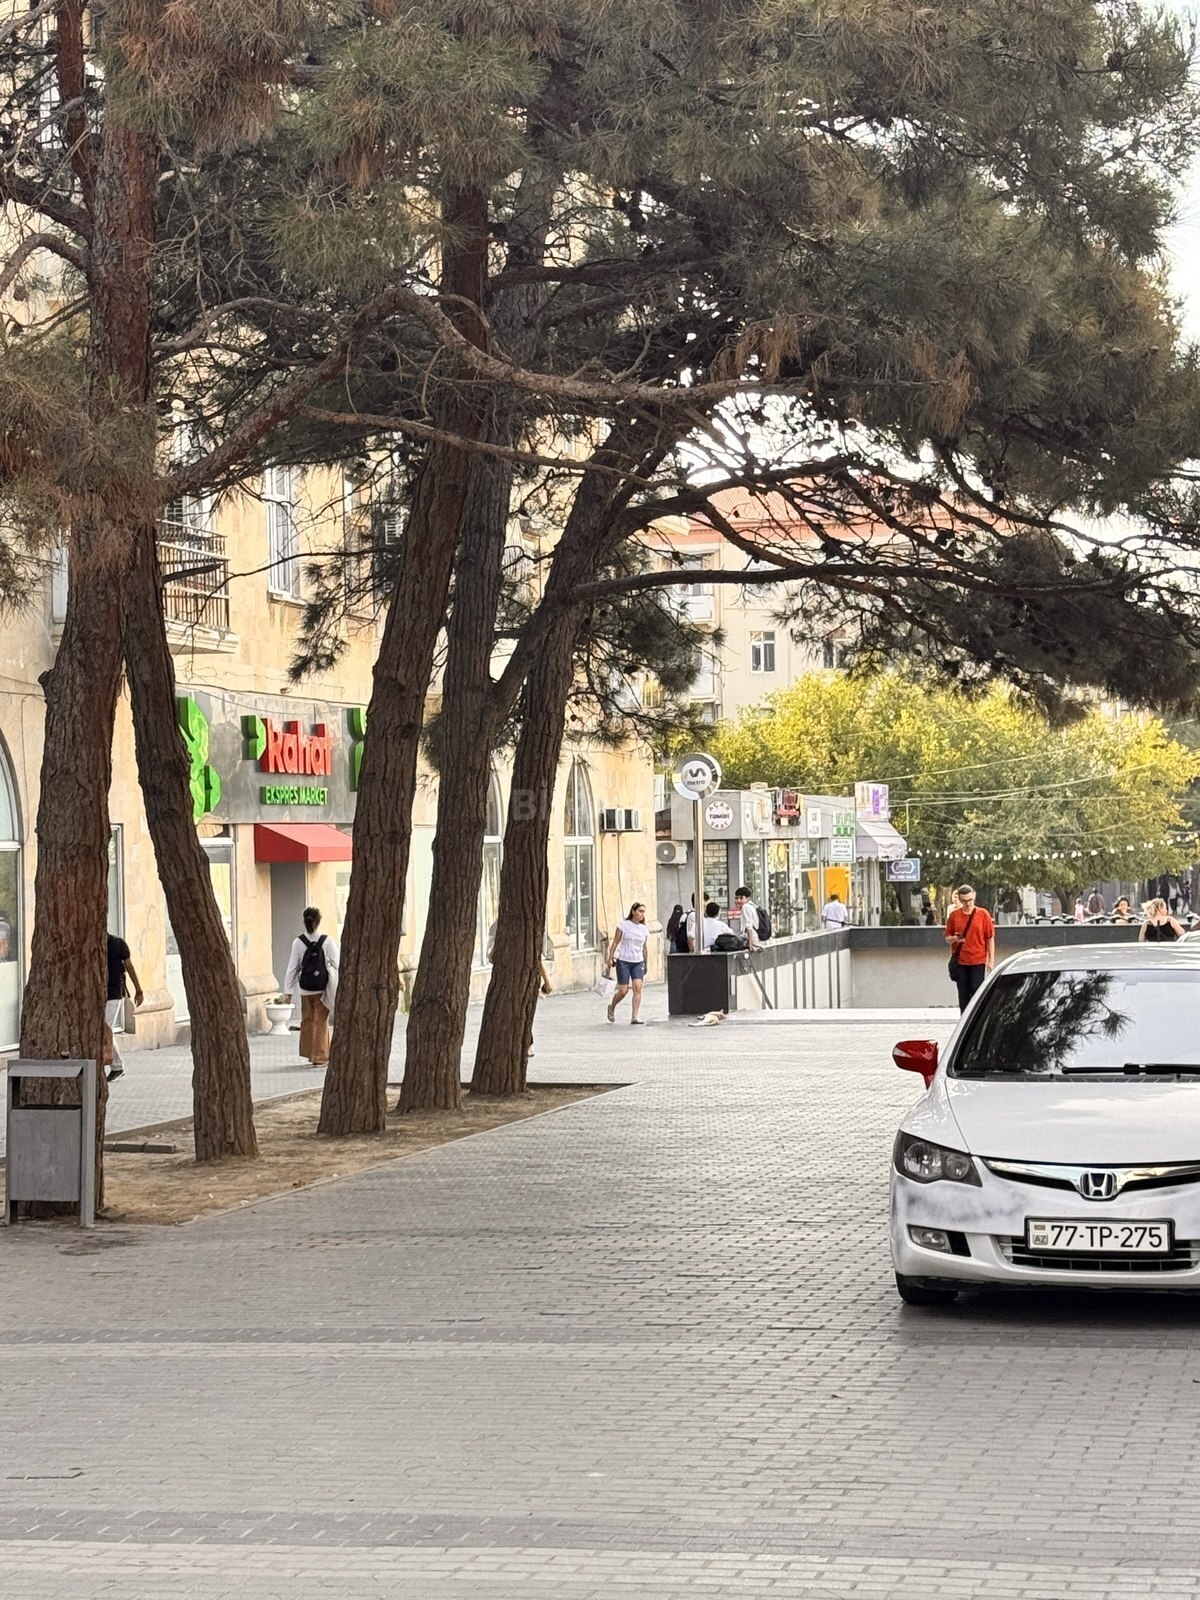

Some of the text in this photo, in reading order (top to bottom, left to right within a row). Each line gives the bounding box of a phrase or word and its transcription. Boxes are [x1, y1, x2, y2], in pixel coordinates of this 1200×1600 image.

[264, 718, 332, 775] Rahat
[686, 779, 706, 787] metro
[263, 786, 328, 806] EKSPRES MARKET
[1051, 1225, 1162, 1248] 77-TP-275
